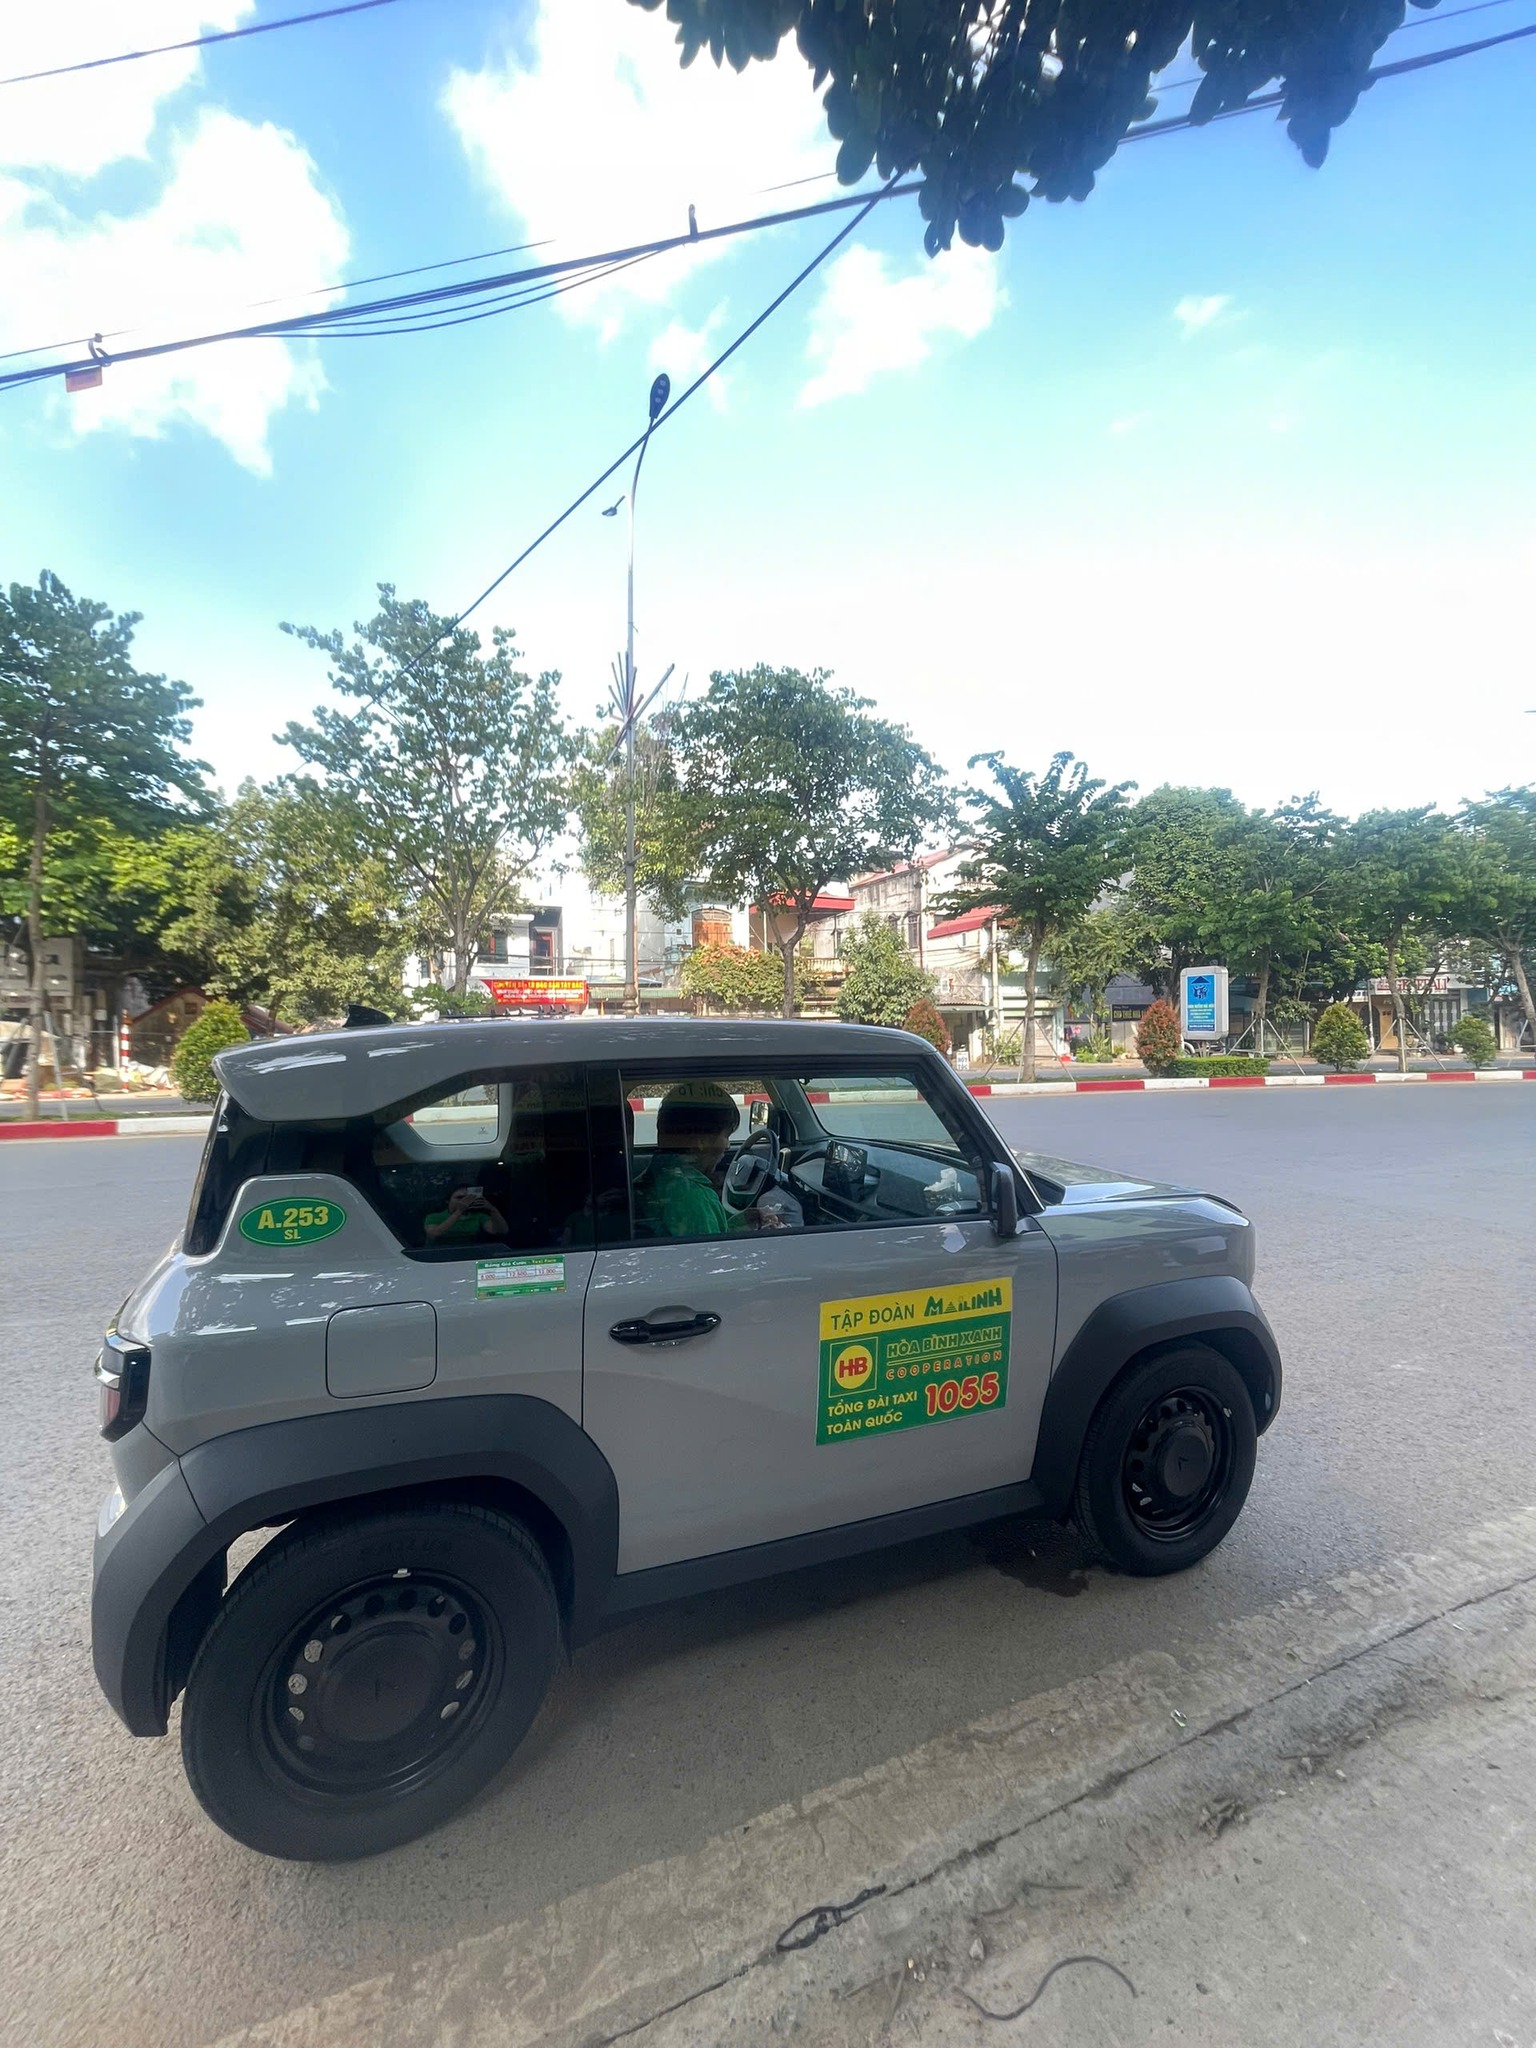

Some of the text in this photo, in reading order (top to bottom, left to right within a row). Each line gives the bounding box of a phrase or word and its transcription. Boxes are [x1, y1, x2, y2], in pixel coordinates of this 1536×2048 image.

[257, 1206, 329, 1230] A.253
[284, 1229, 301, 1240] SL
[831, 1309, 863, 1332] TẬP
[869, 1301, 915, 1325] ĐOÀN
[887, 1326, 1002, 1359] HÒA BÌNH XANH
[838, 1356, 868, 1379] HB
[886, 1350, 1002, 1380] COOPERATION
[828, 1391, 918, 1417] TỔNG ĐÀI TAXI
[925, 1371, 1000, 1417] 1055
[826, 1409, 903, 1435] TOÀN QUỐC
